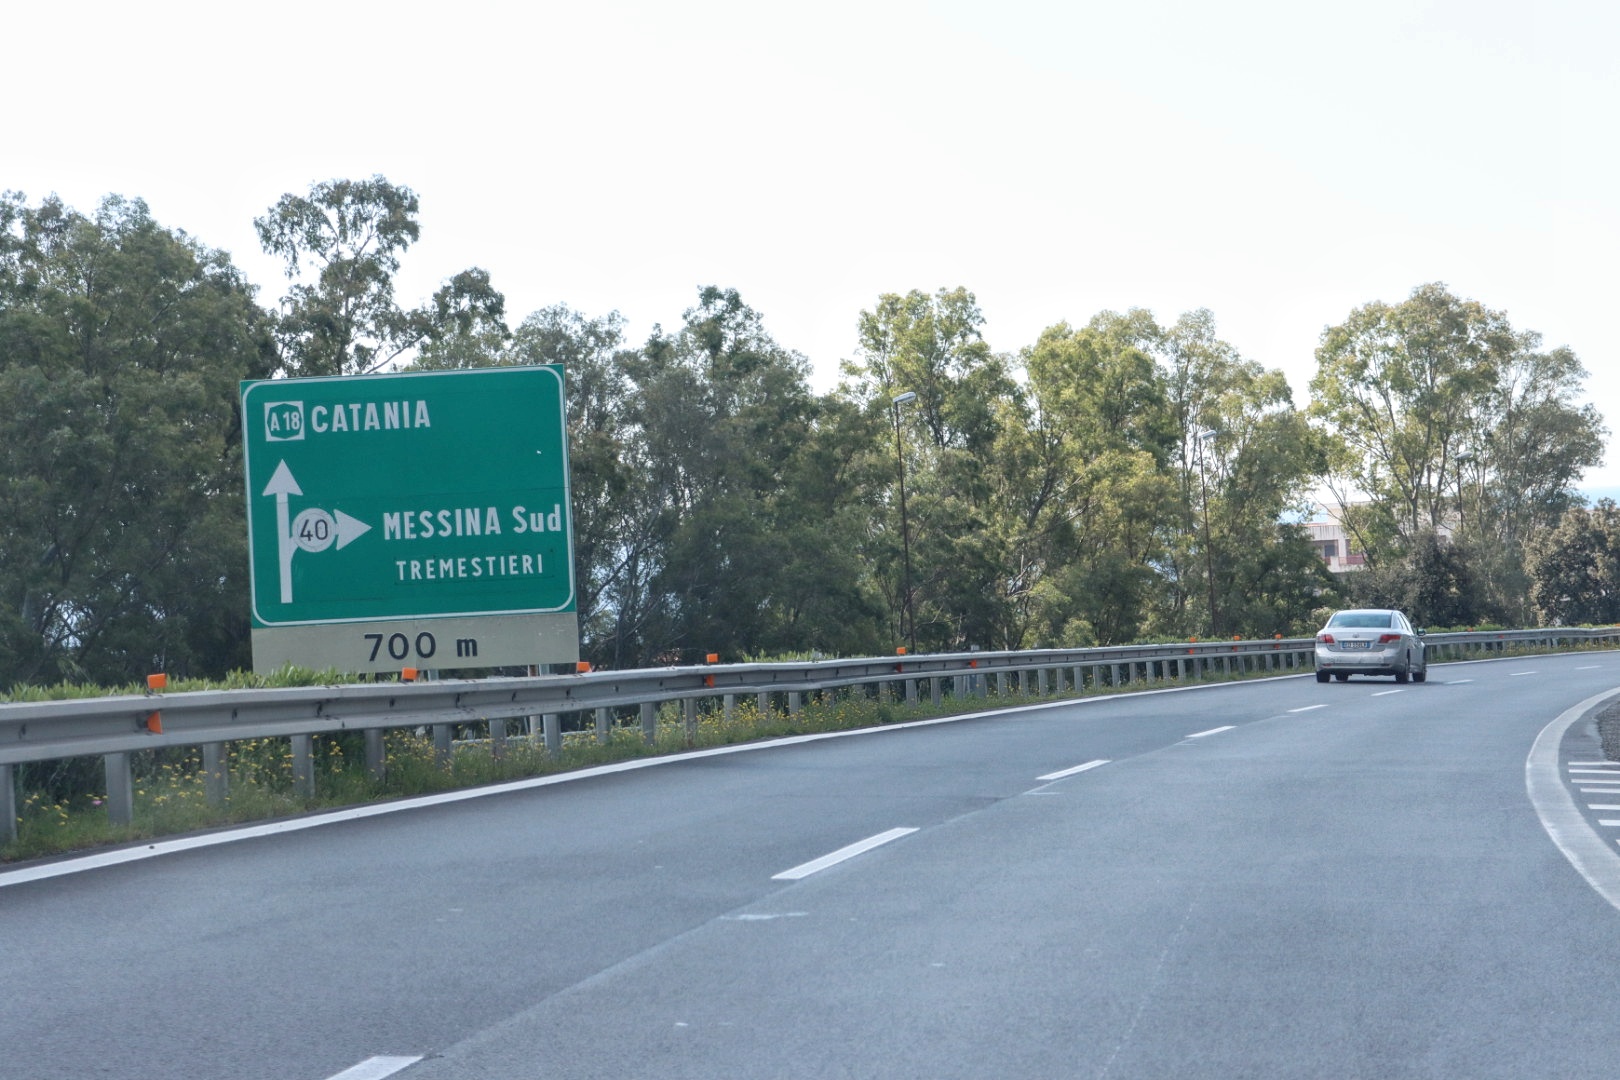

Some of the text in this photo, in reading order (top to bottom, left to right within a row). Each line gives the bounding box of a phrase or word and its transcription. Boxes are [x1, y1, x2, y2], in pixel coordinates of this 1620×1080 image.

[311, 400, 431, 433] CATANIA
[299, 518, 328, 541] 40
[383, 503, 561, 540] MESSINA Sud
[396, 554, 543, 580] TREMESTIERI
[364, 632, 478, 662] 700 m
